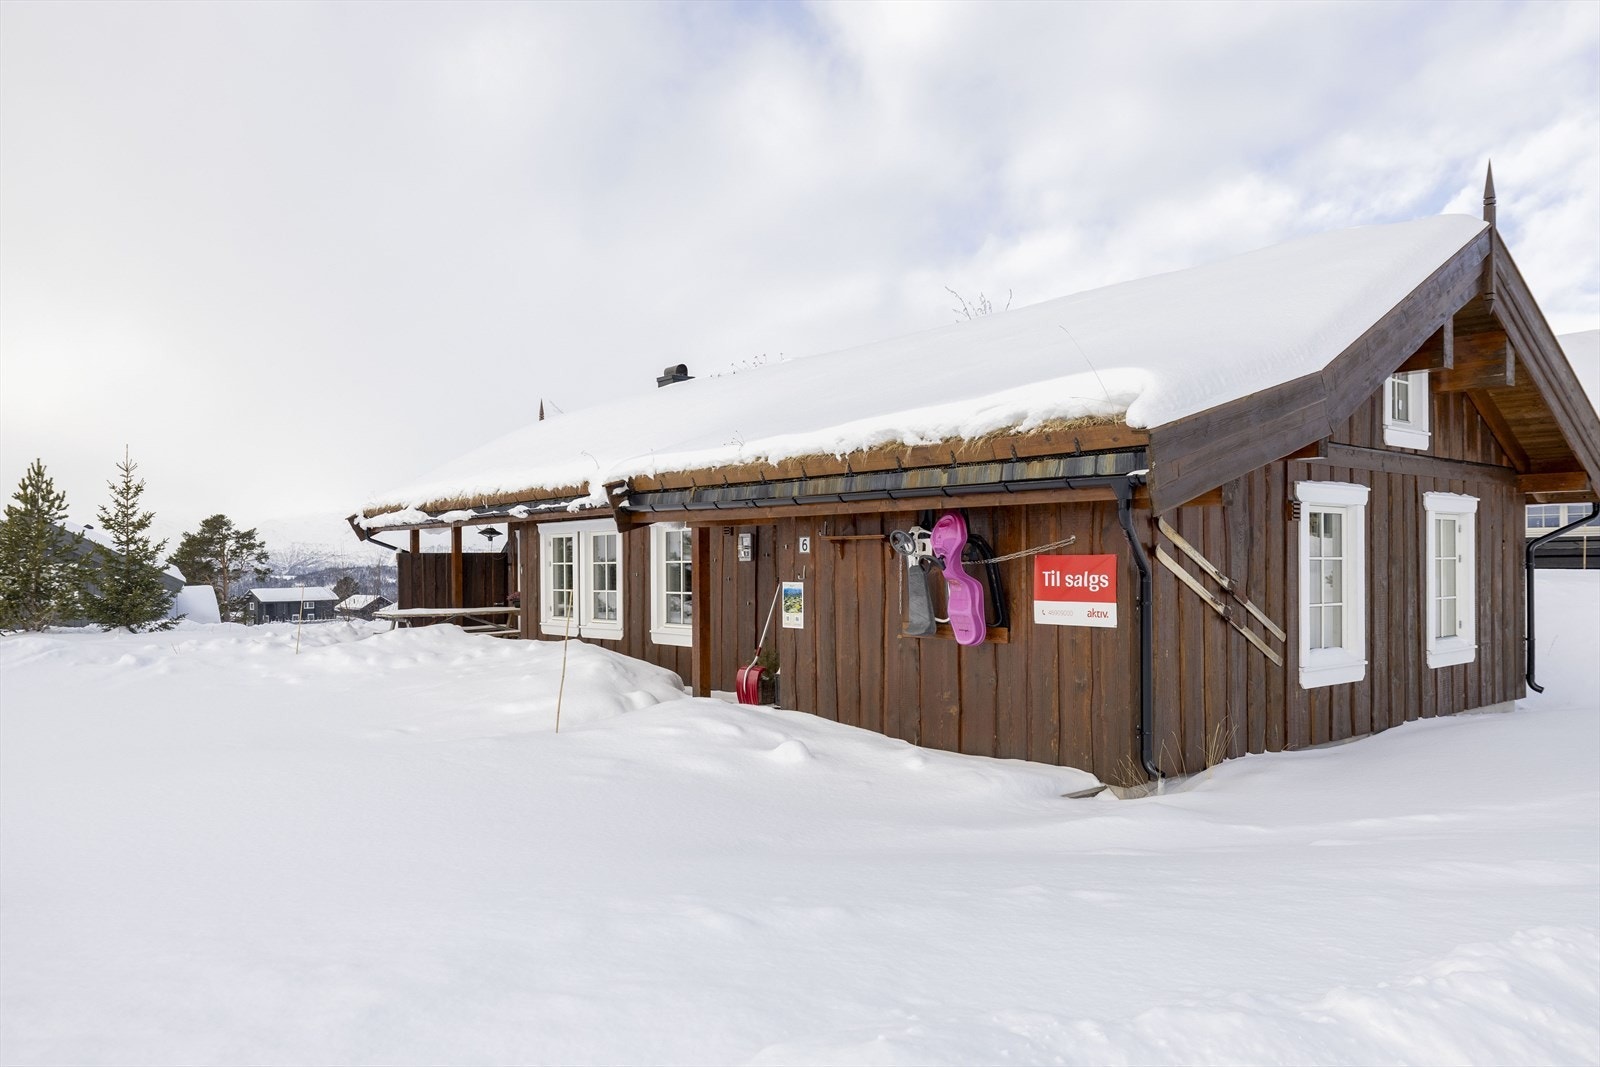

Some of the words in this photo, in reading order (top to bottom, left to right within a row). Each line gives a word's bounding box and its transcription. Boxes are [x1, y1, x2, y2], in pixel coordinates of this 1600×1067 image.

[801, 539, 808, 551] 6
[1042, 570, 1060, 587] Til
[1065, 571, 1109, 592] salgs
